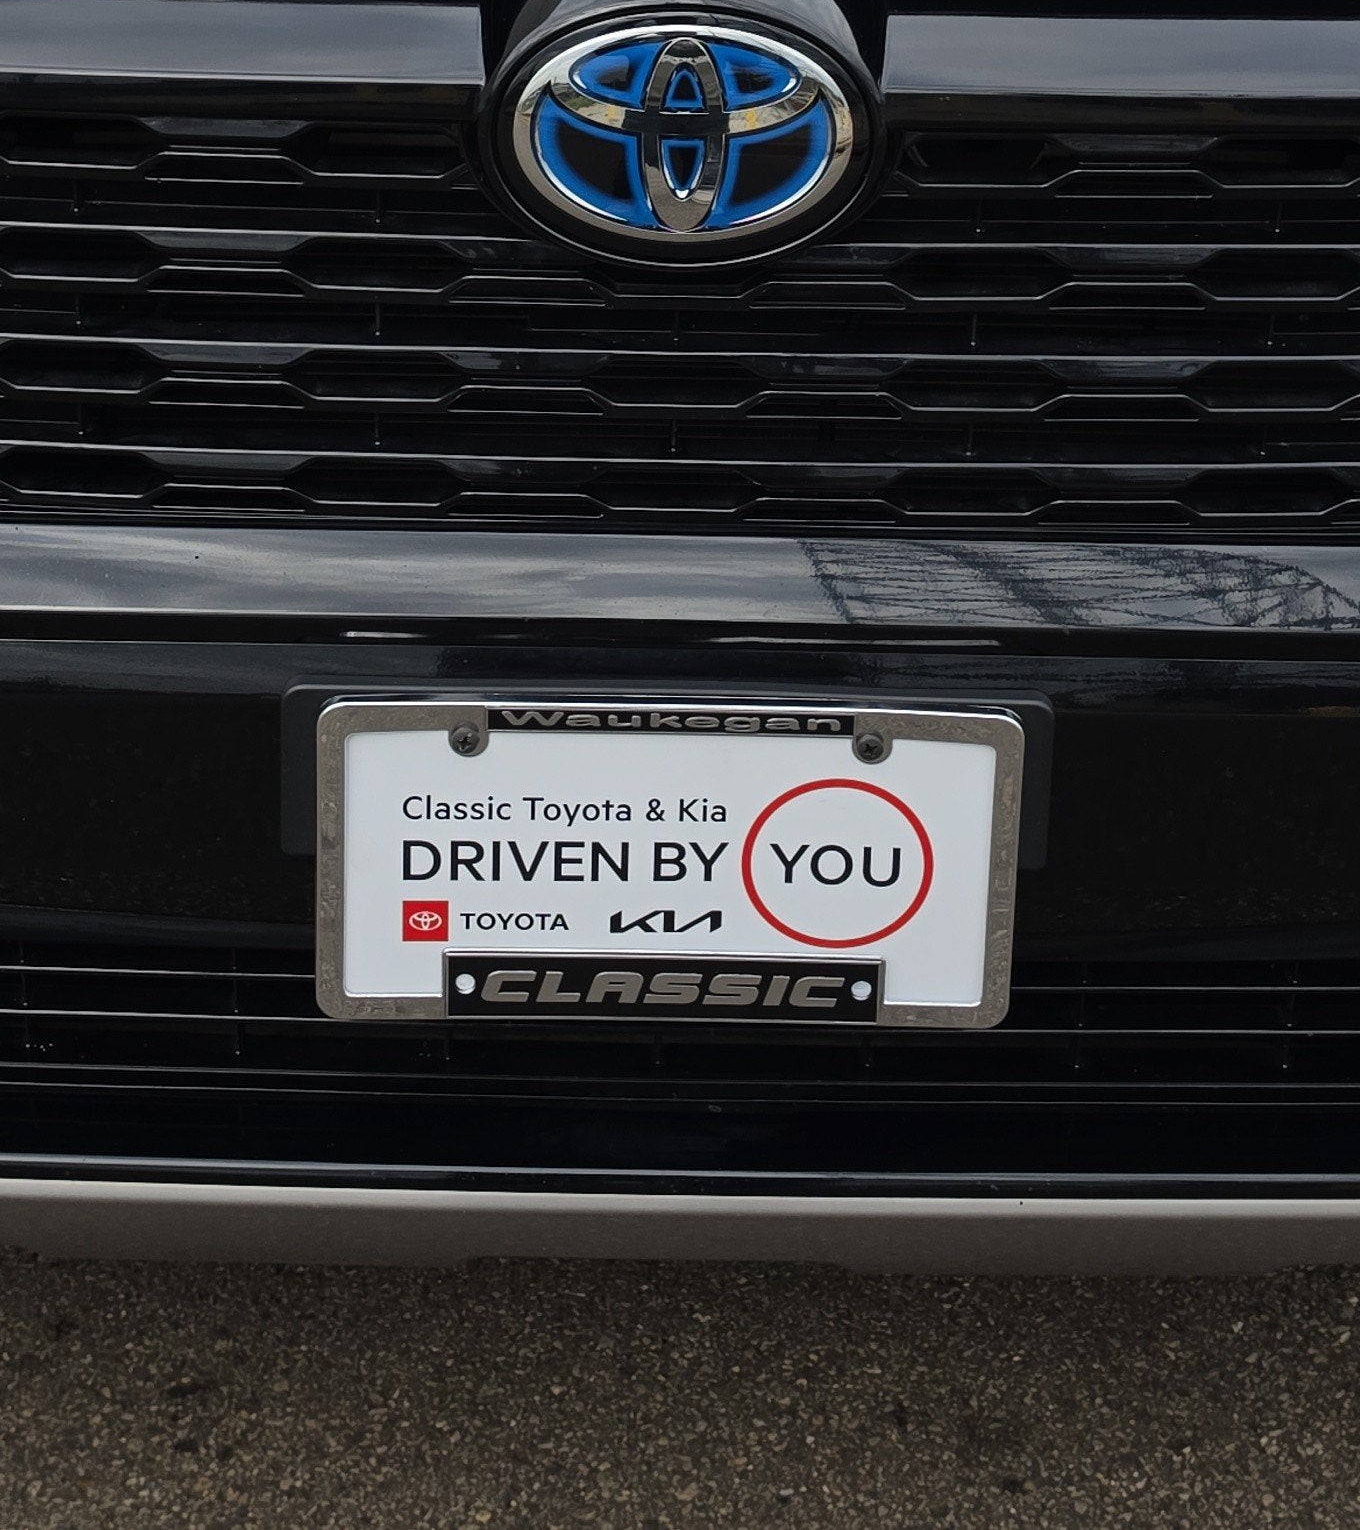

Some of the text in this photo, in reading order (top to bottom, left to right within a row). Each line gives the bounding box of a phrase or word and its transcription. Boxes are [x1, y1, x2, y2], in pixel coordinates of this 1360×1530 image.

[502, 709, 842, 734] Waukegan
[402, 795, 728, 826] Classic Toyota & Kia
[402, 840, 902, 888] DRIVEN BY YOU
[460, 913, 570, 932] TOYOTA
[481, 971, 845, 1009] CLASSIC
